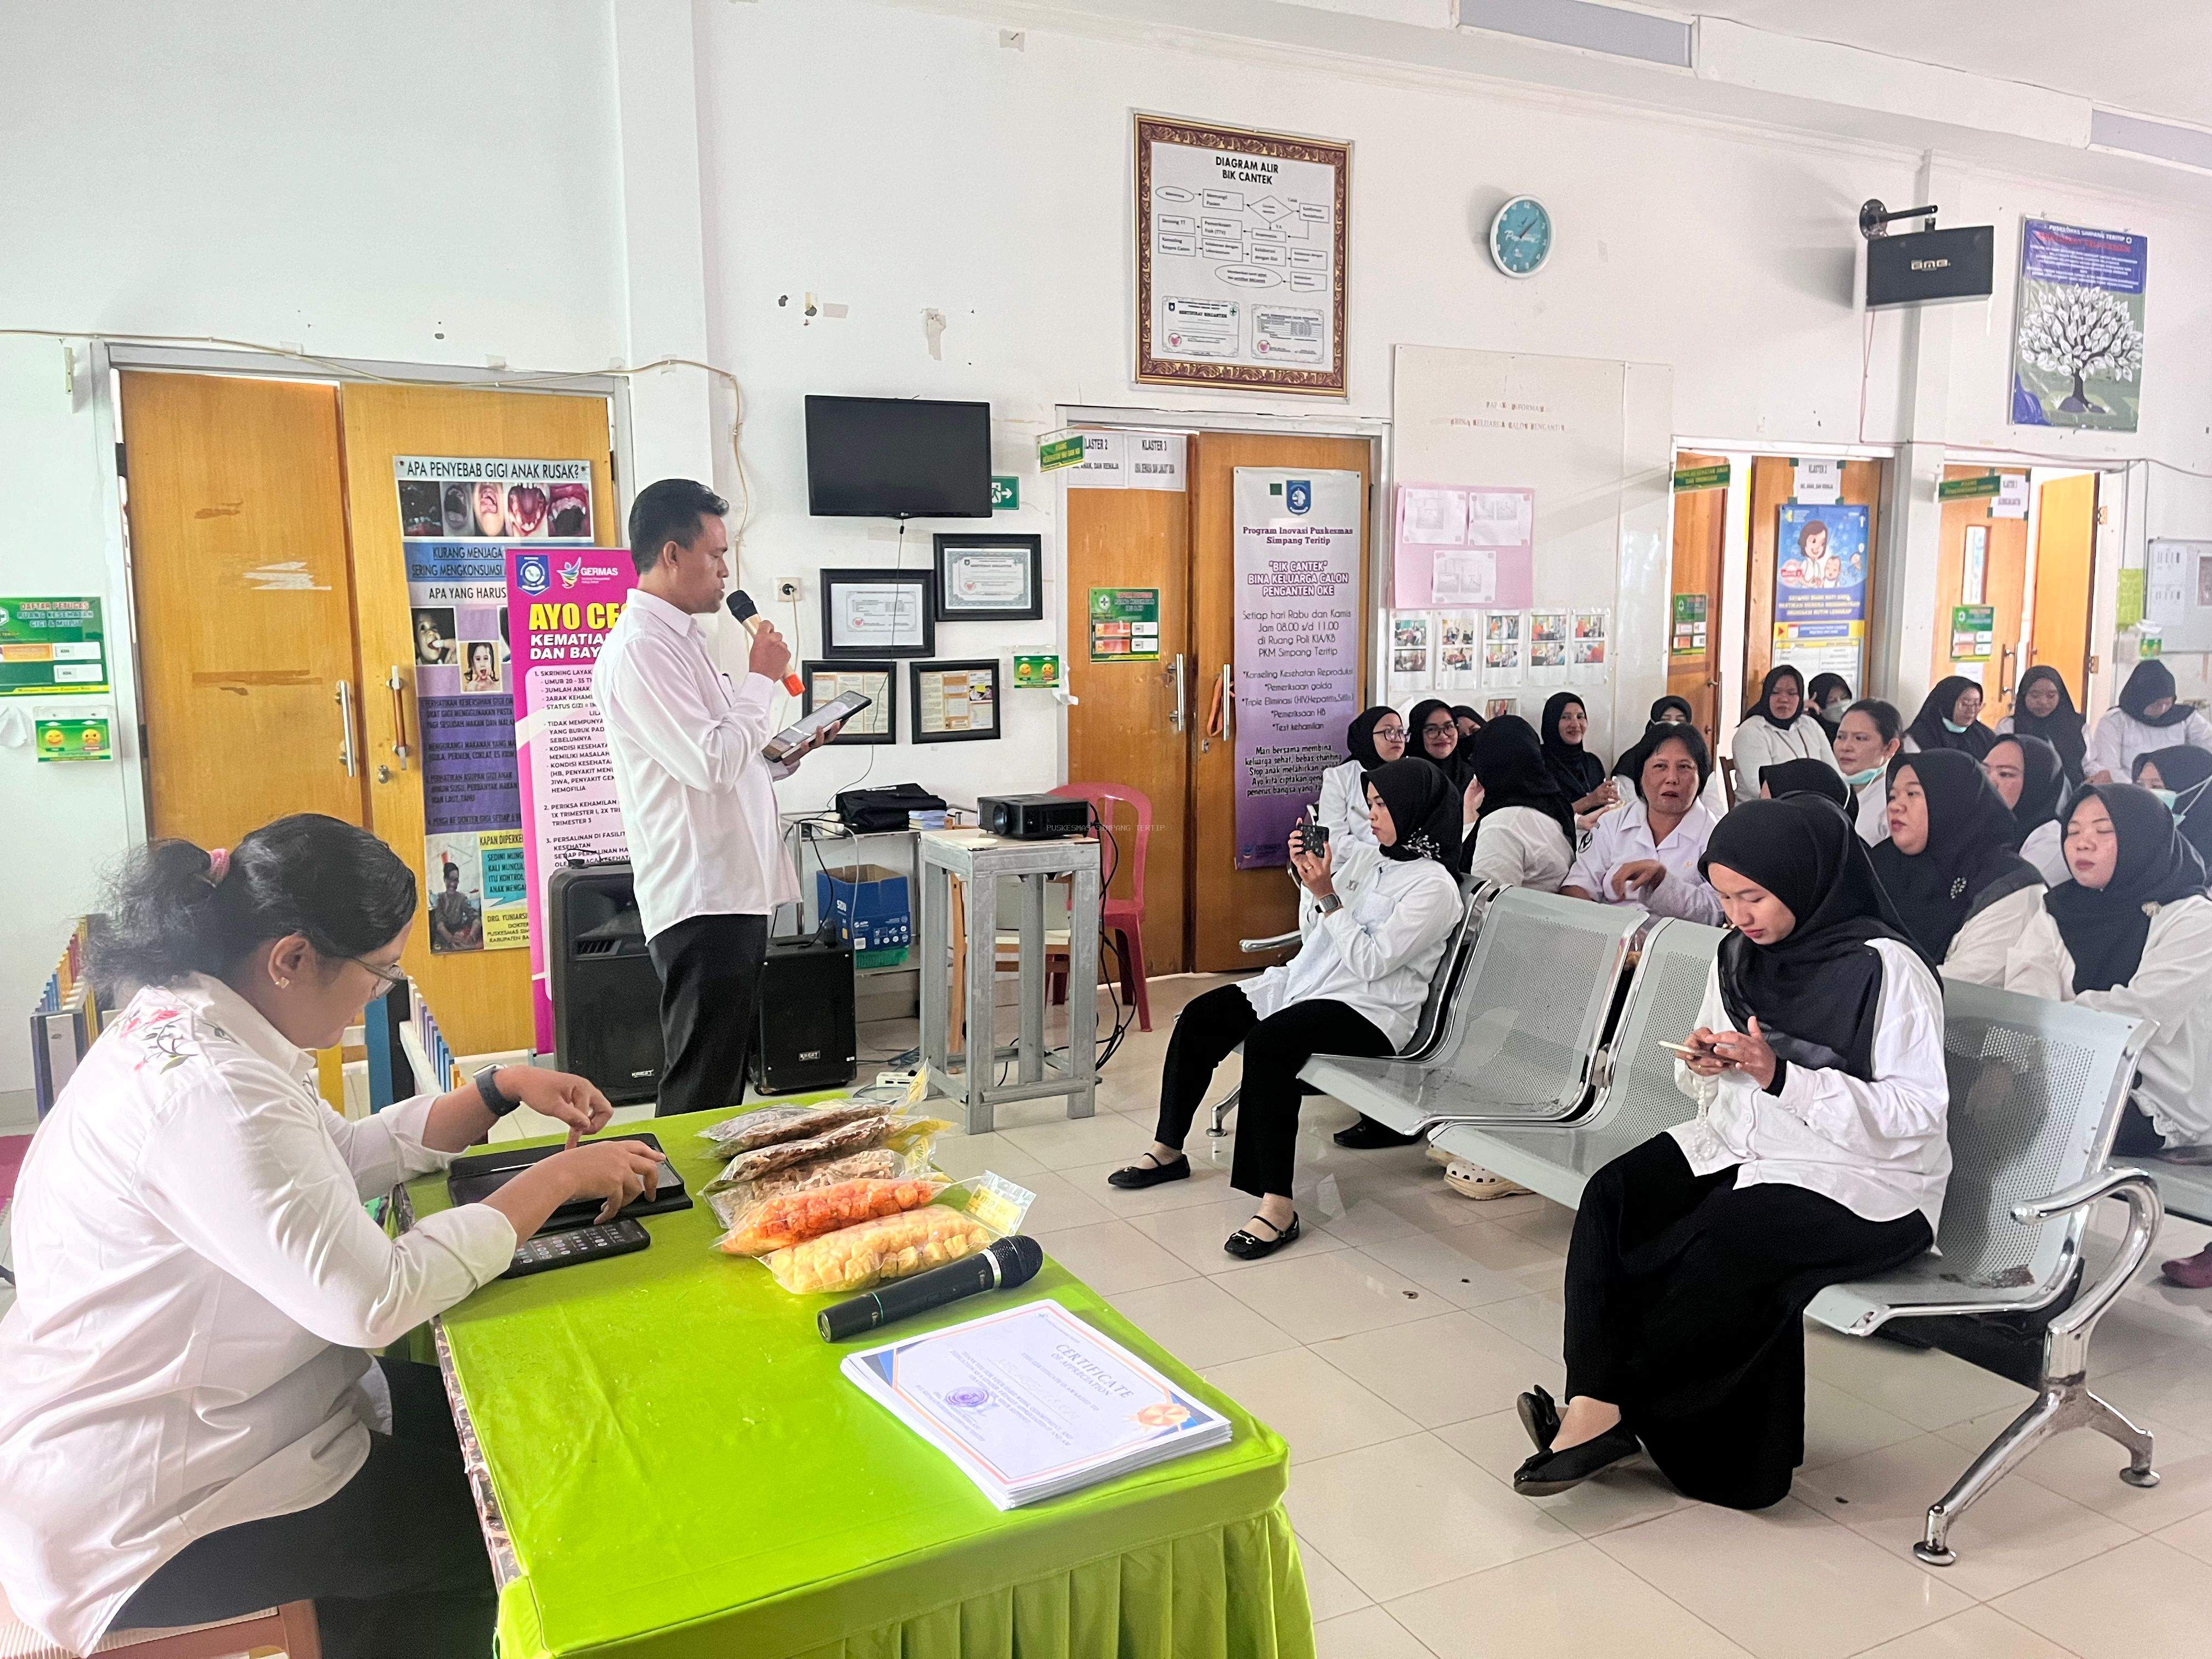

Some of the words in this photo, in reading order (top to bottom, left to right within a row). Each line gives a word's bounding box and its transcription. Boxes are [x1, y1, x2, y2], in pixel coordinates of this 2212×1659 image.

[1216, 156, 1258, 171] DIAGRAM
[1261, 162, 1278, 174] ALIR
[1222, 170, 1235, 180] BIK
[1239, 172, 1272, 185] CANTEK
[1084, 438, 1103, 450] LASTER
[1142, 440, 1163, 451] KLASTER
[407, 460, 427, 477] APA
[430, 461, 482, 477] PENYEBAB
[485, 462, 508, 478] GIGI
[510, 464, 539, 478] ANAK
[543, 465, 579, 479] RUSAK?
[1243, 527, 1277, 535] Program
[1267, 537, 1302, 545] Simpang
[1305, 537, 1330, 545] Teritip
[433, 547, 465, 558] KURANG
[580, 567, 618, 575] GERMAS
[1248, 574, 1269, 584] BINA
[1272, 573, 1317, 584] KELUARGA
[1319, 573, 1348, 584] CALON
[429, 588, 447, 599] APA
[449, 588, 473, 599] YANG
[476, 588, 506, 598] HARUS
[1263, 585, 1314, 596] PENGANTEN
[1317, 585, 1334, 596] OKE
[528, 603, 580, 630] AYO
[1243, 611, 1267, 620] Setiap
[1271, 611, 1285, 619] hari
[1288, 611, 1308, 619] Rabu
[1312, 610, 1327, 618] dan
[1330, 609, 1351, 618] Kamis
[1259, 623, 1274, 633] Jam
[1277, 623, 1299, 631] 08.00
[1301, 622, 1313, 631] s/d
[1318, 622, 1339, 630] 11.00
[1257, 636, 1265, 645] di
[1268, 636, 1293, 645] Ruang
[1296, 635, 1310, 644] Poli
[1312, 634, 1335, 643] KIA/KB
[530, 647, 565, 659] DAN
[570, 647, 601, 658] BAY
[1259, 648, 1276, 657] PKM
[1279, 648, 1311, 658] Simpang
[1315, 647, 1338, 656] Teritip
[1302, 744, 1331, 753] membina
[1245, 757, 1271, 766] keluarga
[1296, 754, 1314, 763] bebas
[1249, 767, 1263, 776] Stop
[1283, 765, 1318, 773] melahirkan
[1252, 778, 1263, 787] Ayo
[1280, 775, 1307, 785] ciptakan
[1247, 788, 1271, 798] penerus
[1273, 786, 1296, 795] bangsa
[1298, 785, 1313, 793] yang
[479, 836, 498, 846] KAPAN
[553, 834, 592, 843] PERSALINAN
[554, 843, 591, 851] KESEHATAN
[1056, 1344, 1134, 1398] CERTIFICATE
